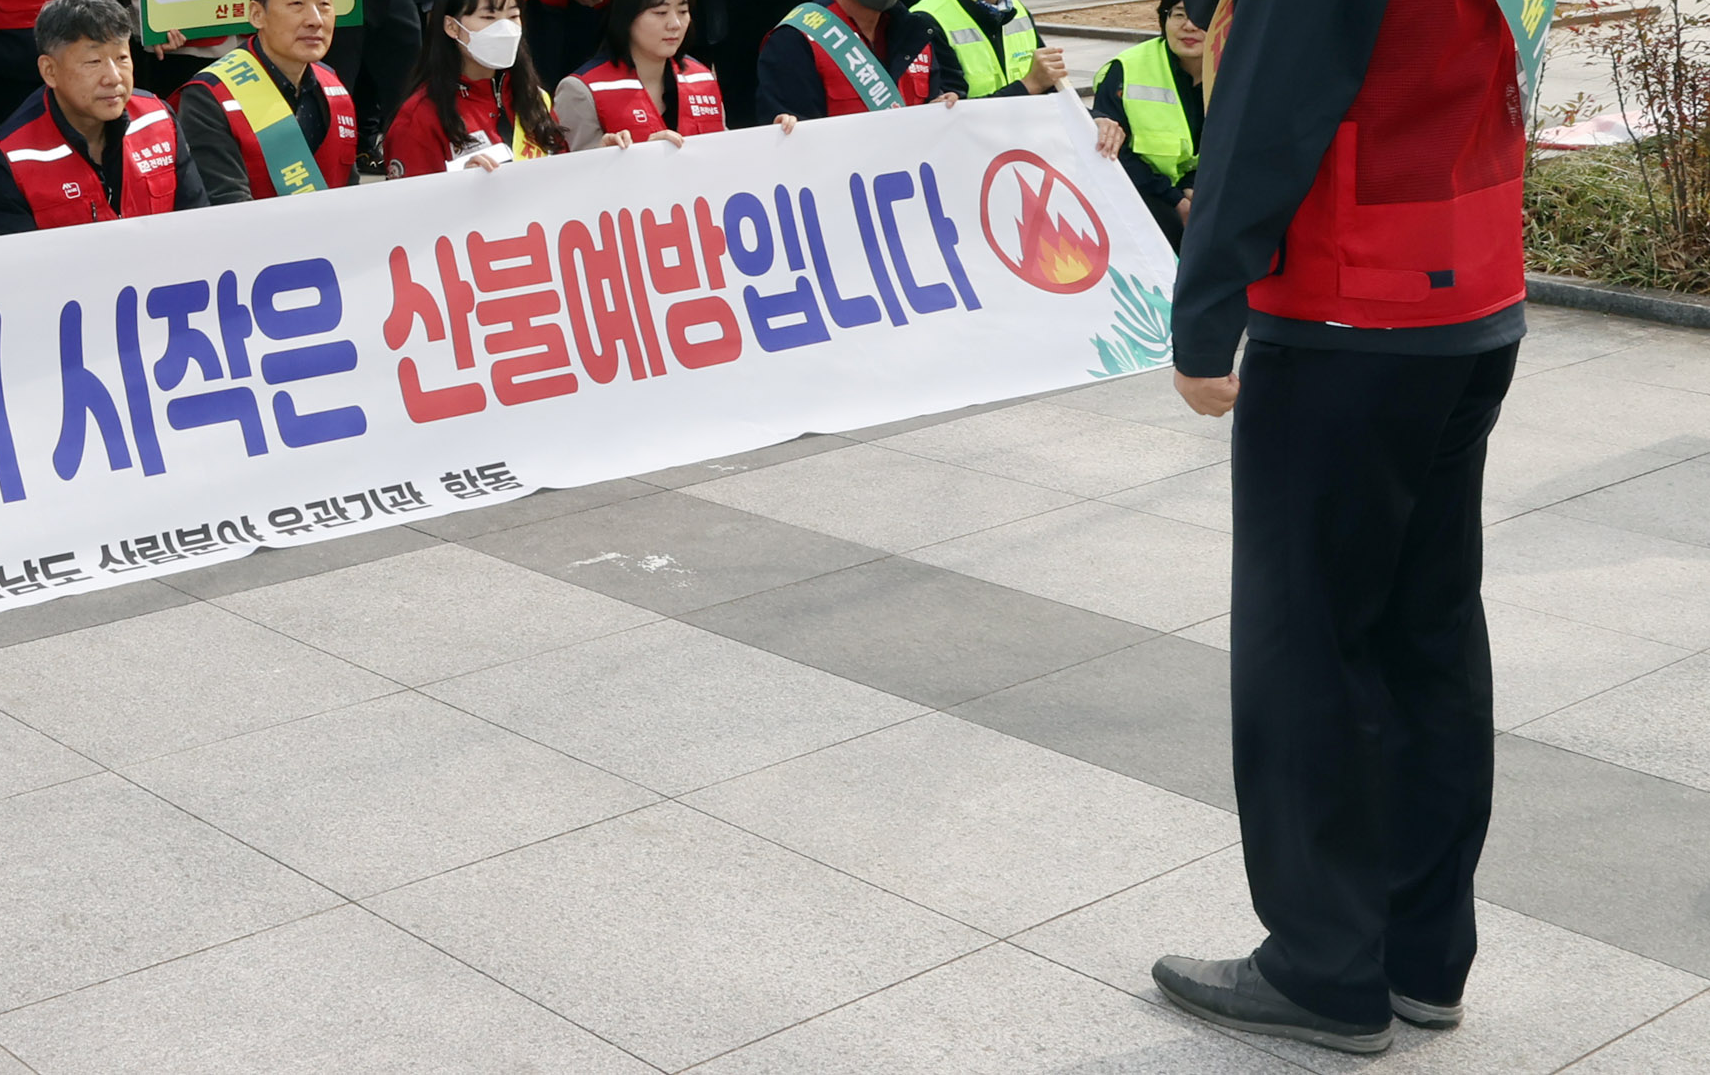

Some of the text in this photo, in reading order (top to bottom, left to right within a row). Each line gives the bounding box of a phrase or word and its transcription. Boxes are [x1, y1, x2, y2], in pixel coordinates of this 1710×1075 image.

[822, 25, 849, 50] 그
[844, 45, 893, 107] 시작은
[132, 140, 171, 162] 산불예방
[53, 257, 367, 482] 시작은
[383, 161, 983, 425] 산불예방입니다
[267, 481, 434, 537] 유관기관
[439, 461, 523, 502] 합동
